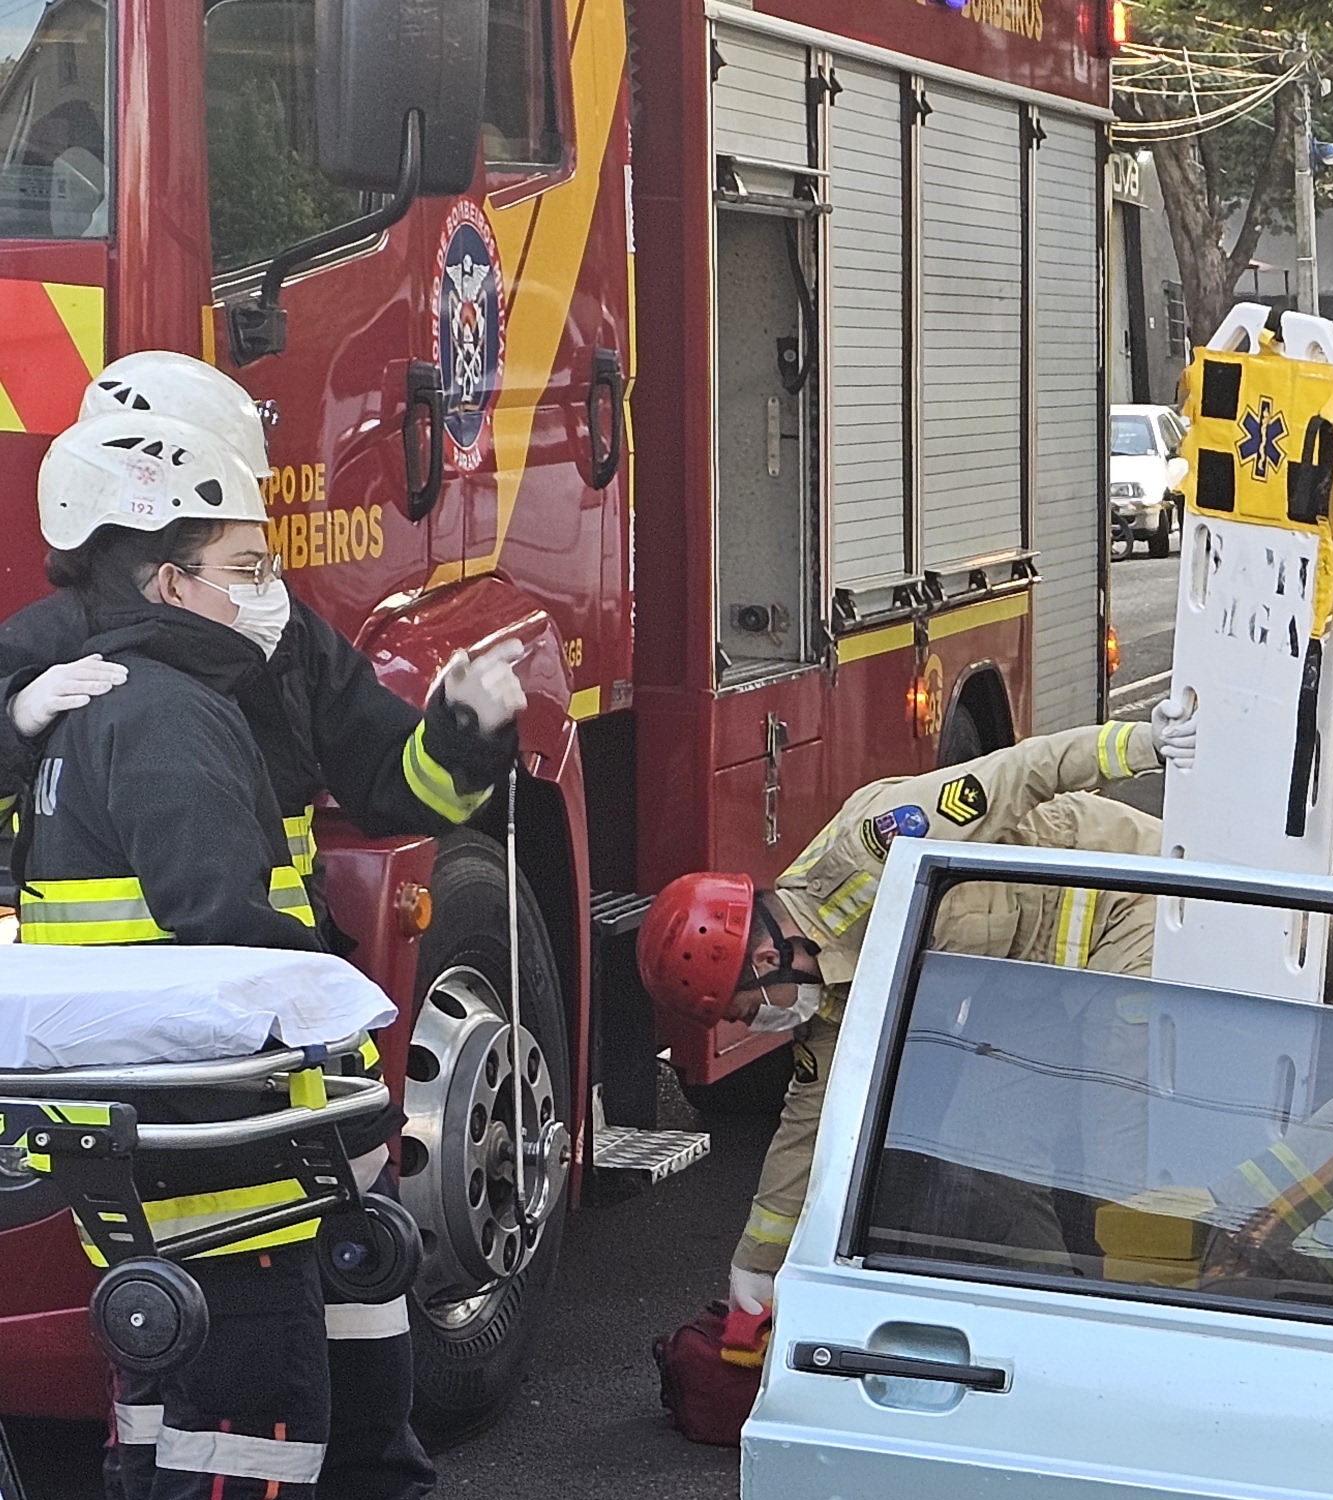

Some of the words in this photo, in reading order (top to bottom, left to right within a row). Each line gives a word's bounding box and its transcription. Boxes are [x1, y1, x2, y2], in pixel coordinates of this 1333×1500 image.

[301, 463, 326, 502] DE
[130, 501, 154, 516] 192
[267, 504, 383, 570] MBEIROS
